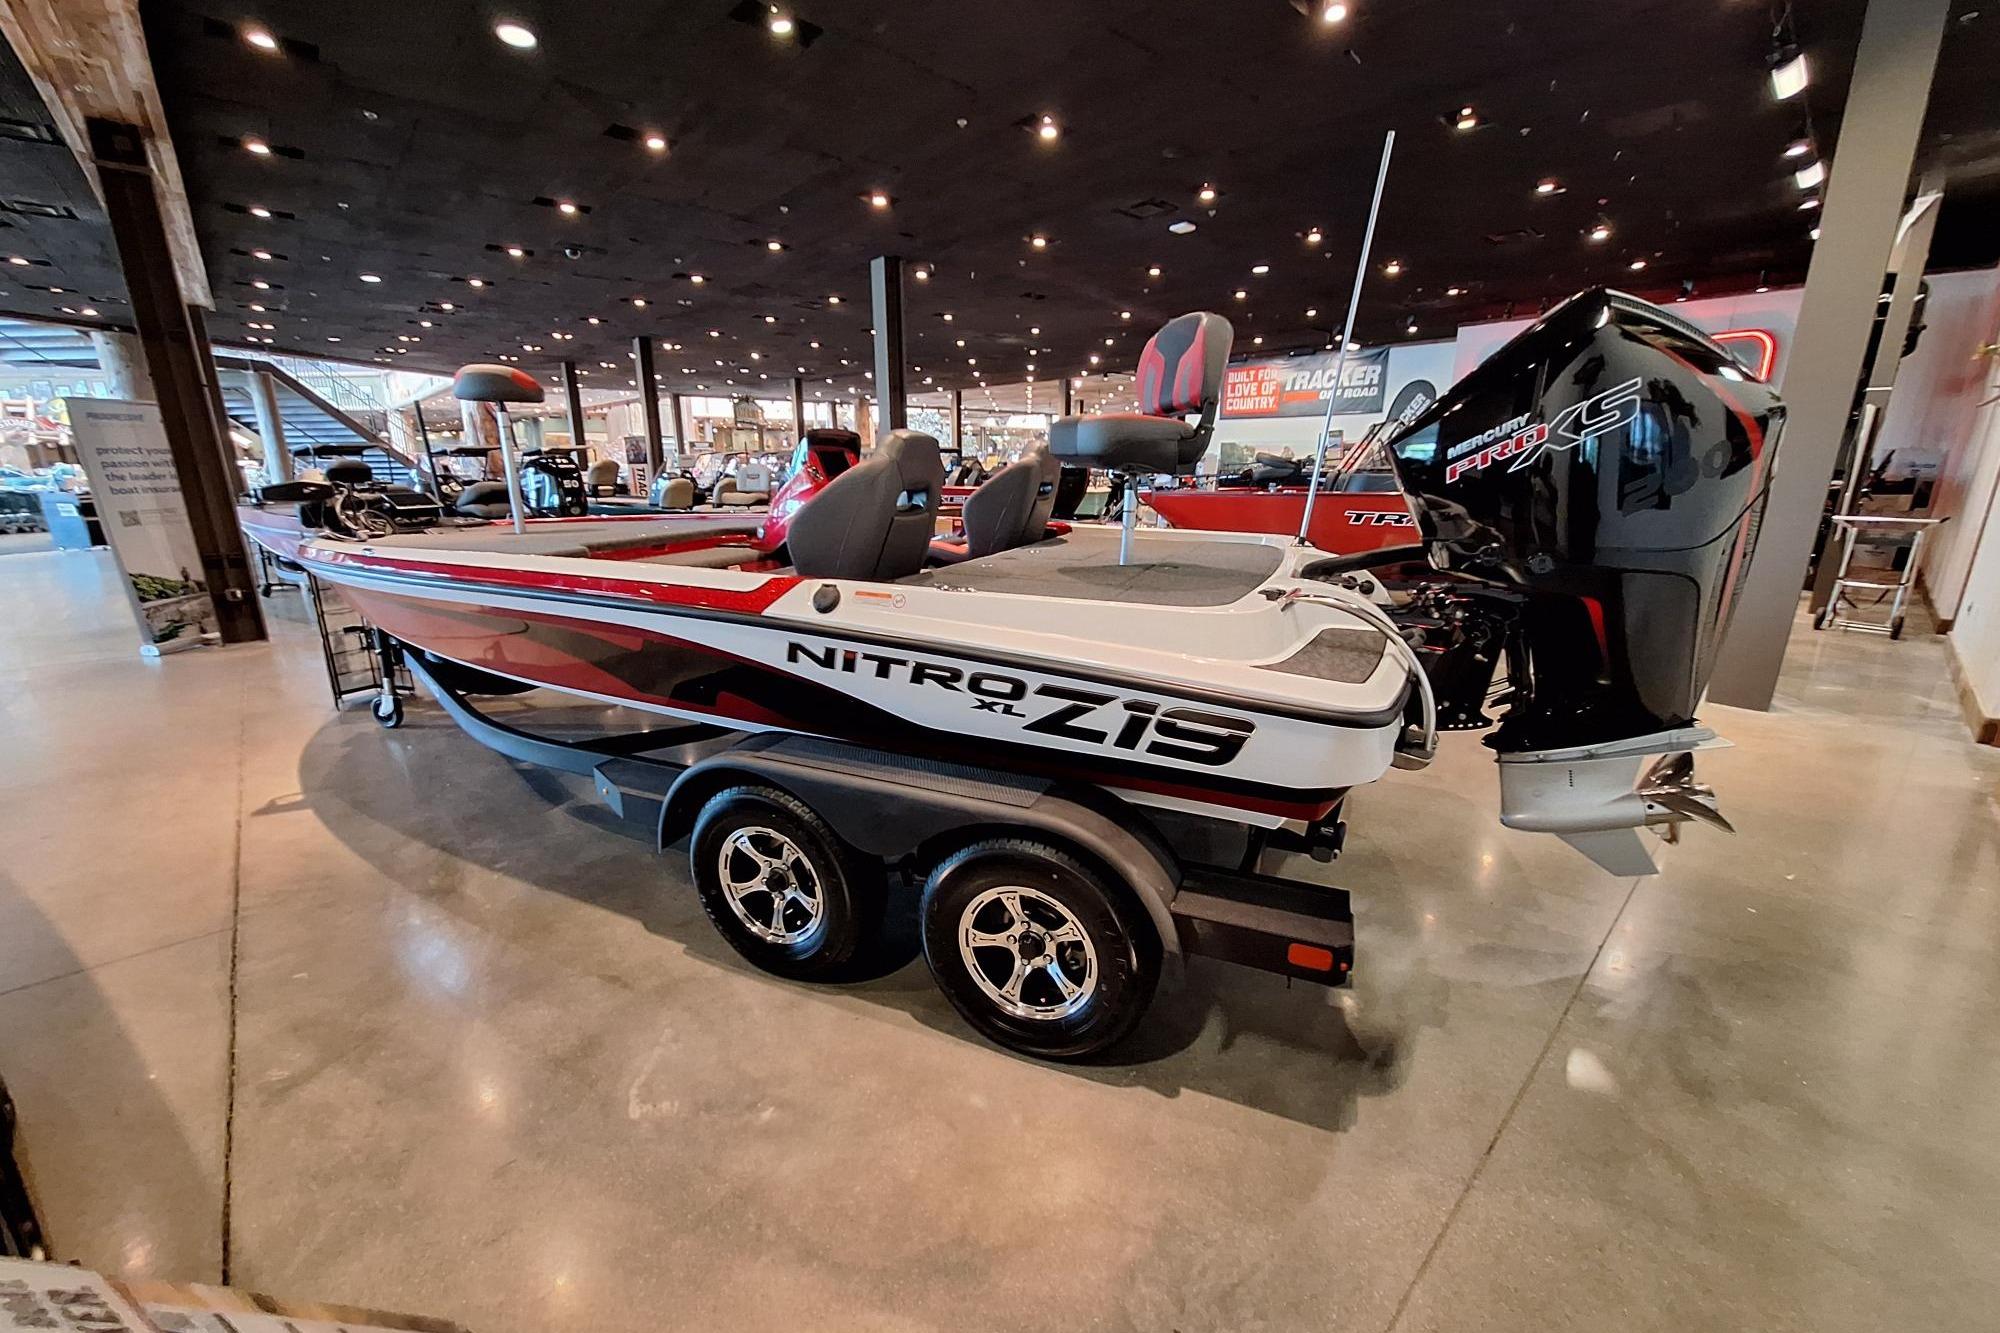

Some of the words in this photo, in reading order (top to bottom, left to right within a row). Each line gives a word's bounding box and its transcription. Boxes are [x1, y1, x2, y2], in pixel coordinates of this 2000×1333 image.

[1228, 370, 1256, 383] BUILT
[1257, 369, 1279, 382] FOR
[1284, 364, 1382, 392] TRACKER
[1227, 383, 1257, 397] LOVE
[1261, 382, 1278, 396] OF
[1318, 388, 1344, 400] OFF
[1343, 386, 1378, 399] ROAD
[1226, 397, 1277, 411] COUNTRY.
[1446, 423, 1549, 484] PRO
[1507, 376, 1642, 474] XS
[1447, 412, 1531, 459] MERCURY
[96, 446, 143, 456] protect
[100, 459, 149, 470] passion
[105, 472, 128, 481] the
[129, 471, 166, 480] leader
[109, 485, 139, 495] boat
[787, 641, 1027, 701] NITRO
[1021, 682, 1257, 767] Z19
[970, 698, 1027, 718] XL
